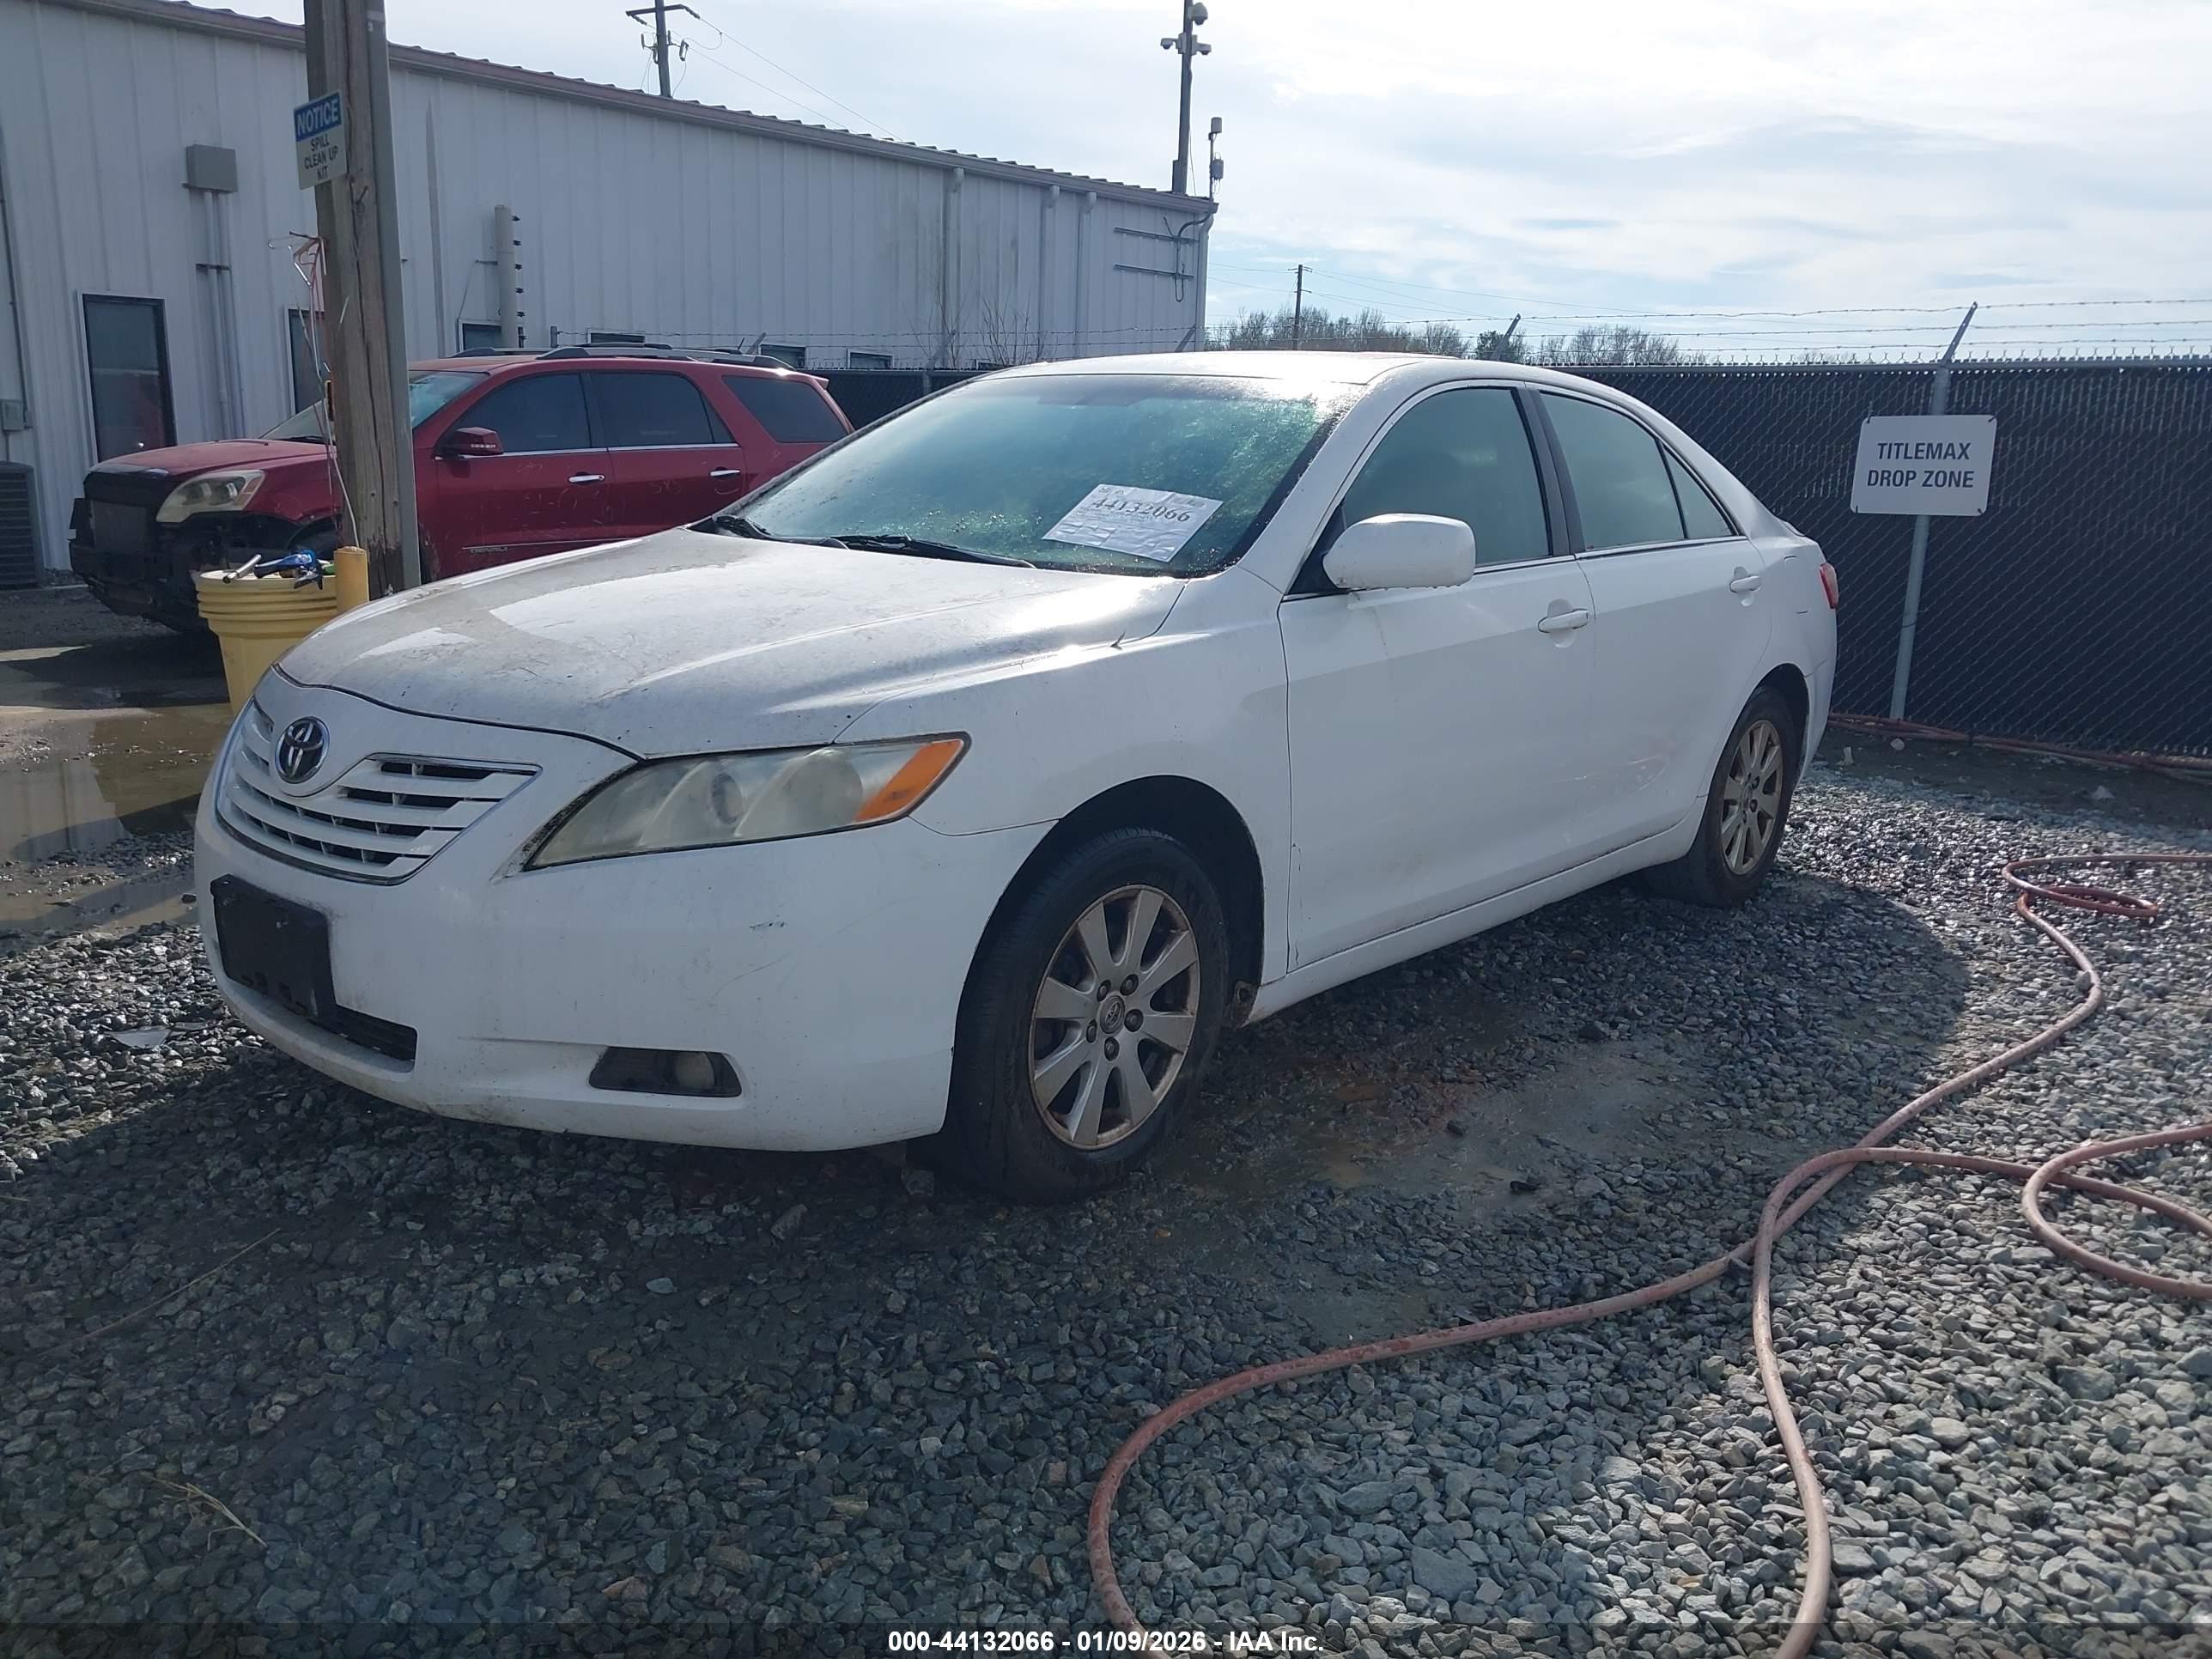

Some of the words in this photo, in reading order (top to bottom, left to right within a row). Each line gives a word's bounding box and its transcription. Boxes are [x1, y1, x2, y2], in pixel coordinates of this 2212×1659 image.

[296, 99, 338, 137] NOTICE
[310, 134, 330, 151] SPILL
[304, 150, 327, 169] CLEAN
[329, 146, 338, 161] UP
[317, 166, 328, 180] KIT
[1877, 442, 1972, 460] TITLEMAX
[1867, 469, 1917, 487] DROP
[1922, 470, 1974, 488] ZONE
[1091, 497, 1194, 522] 44132066
